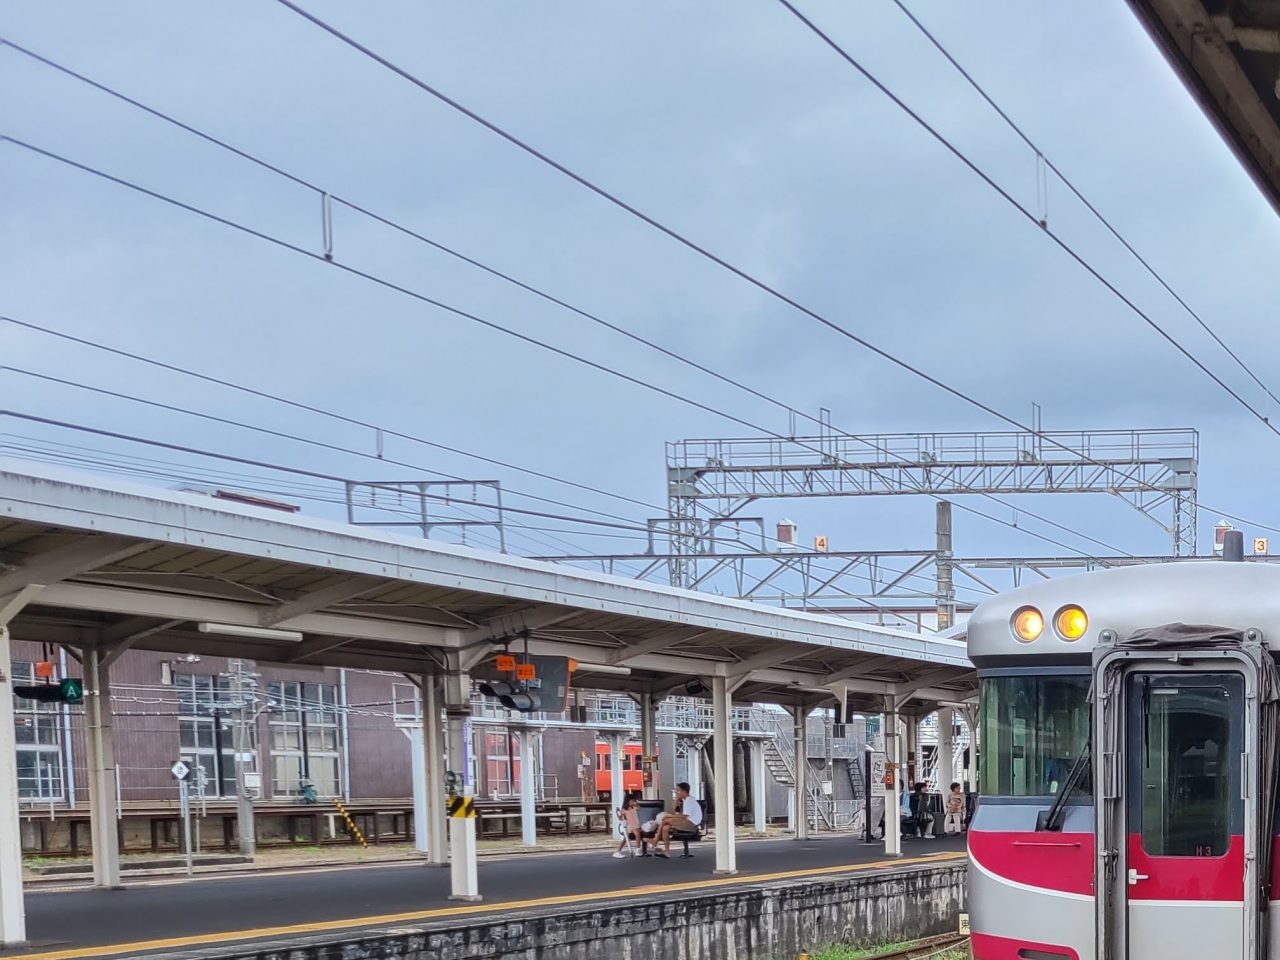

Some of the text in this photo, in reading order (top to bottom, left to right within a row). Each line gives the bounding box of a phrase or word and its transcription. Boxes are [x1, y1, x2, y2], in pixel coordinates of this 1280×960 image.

[818, 538, 825, 549] 4
[1257, 540, 1265, 551] 3
[66, 685, 77, 698] A
